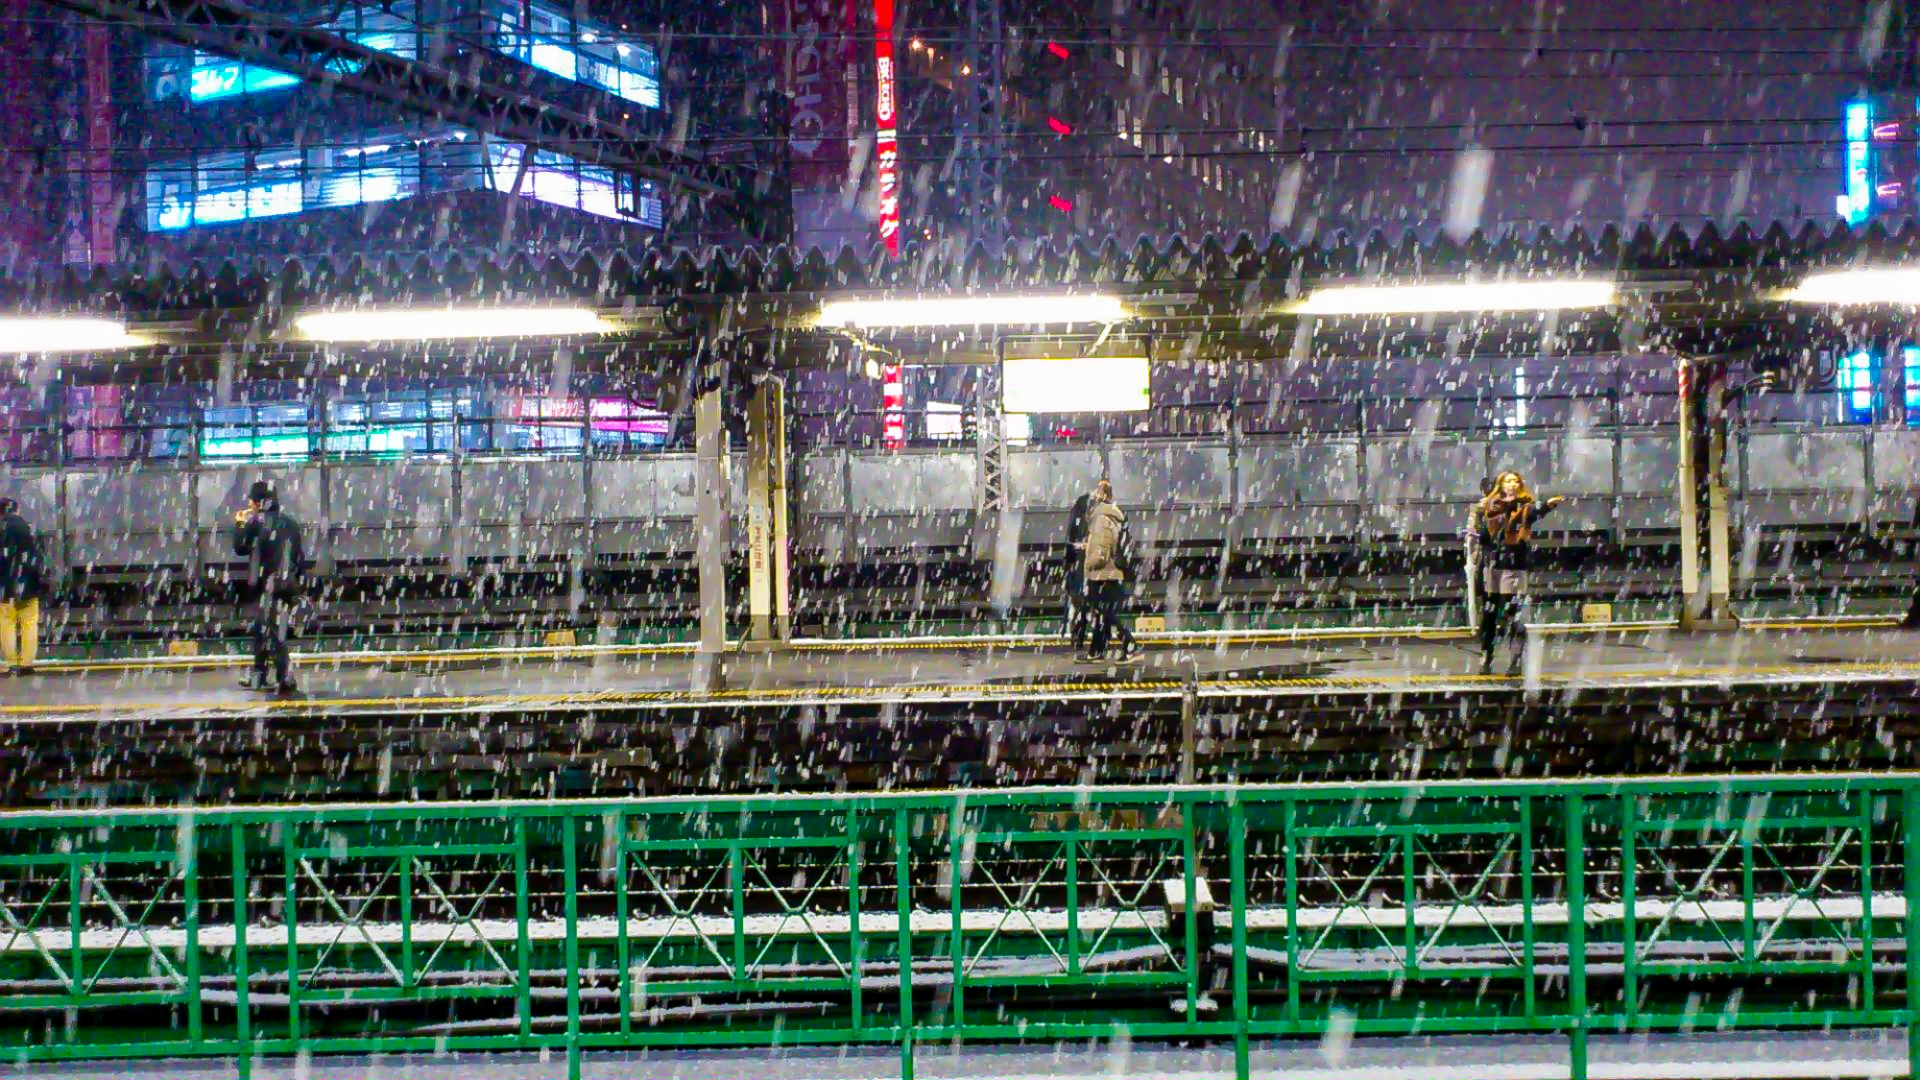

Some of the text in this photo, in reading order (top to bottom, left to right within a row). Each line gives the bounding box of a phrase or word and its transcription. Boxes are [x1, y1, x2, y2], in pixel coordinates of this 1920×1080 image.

[877, 57, 891, 120] BIG ECHO
[880, 150, 898, 238] カラオケ
